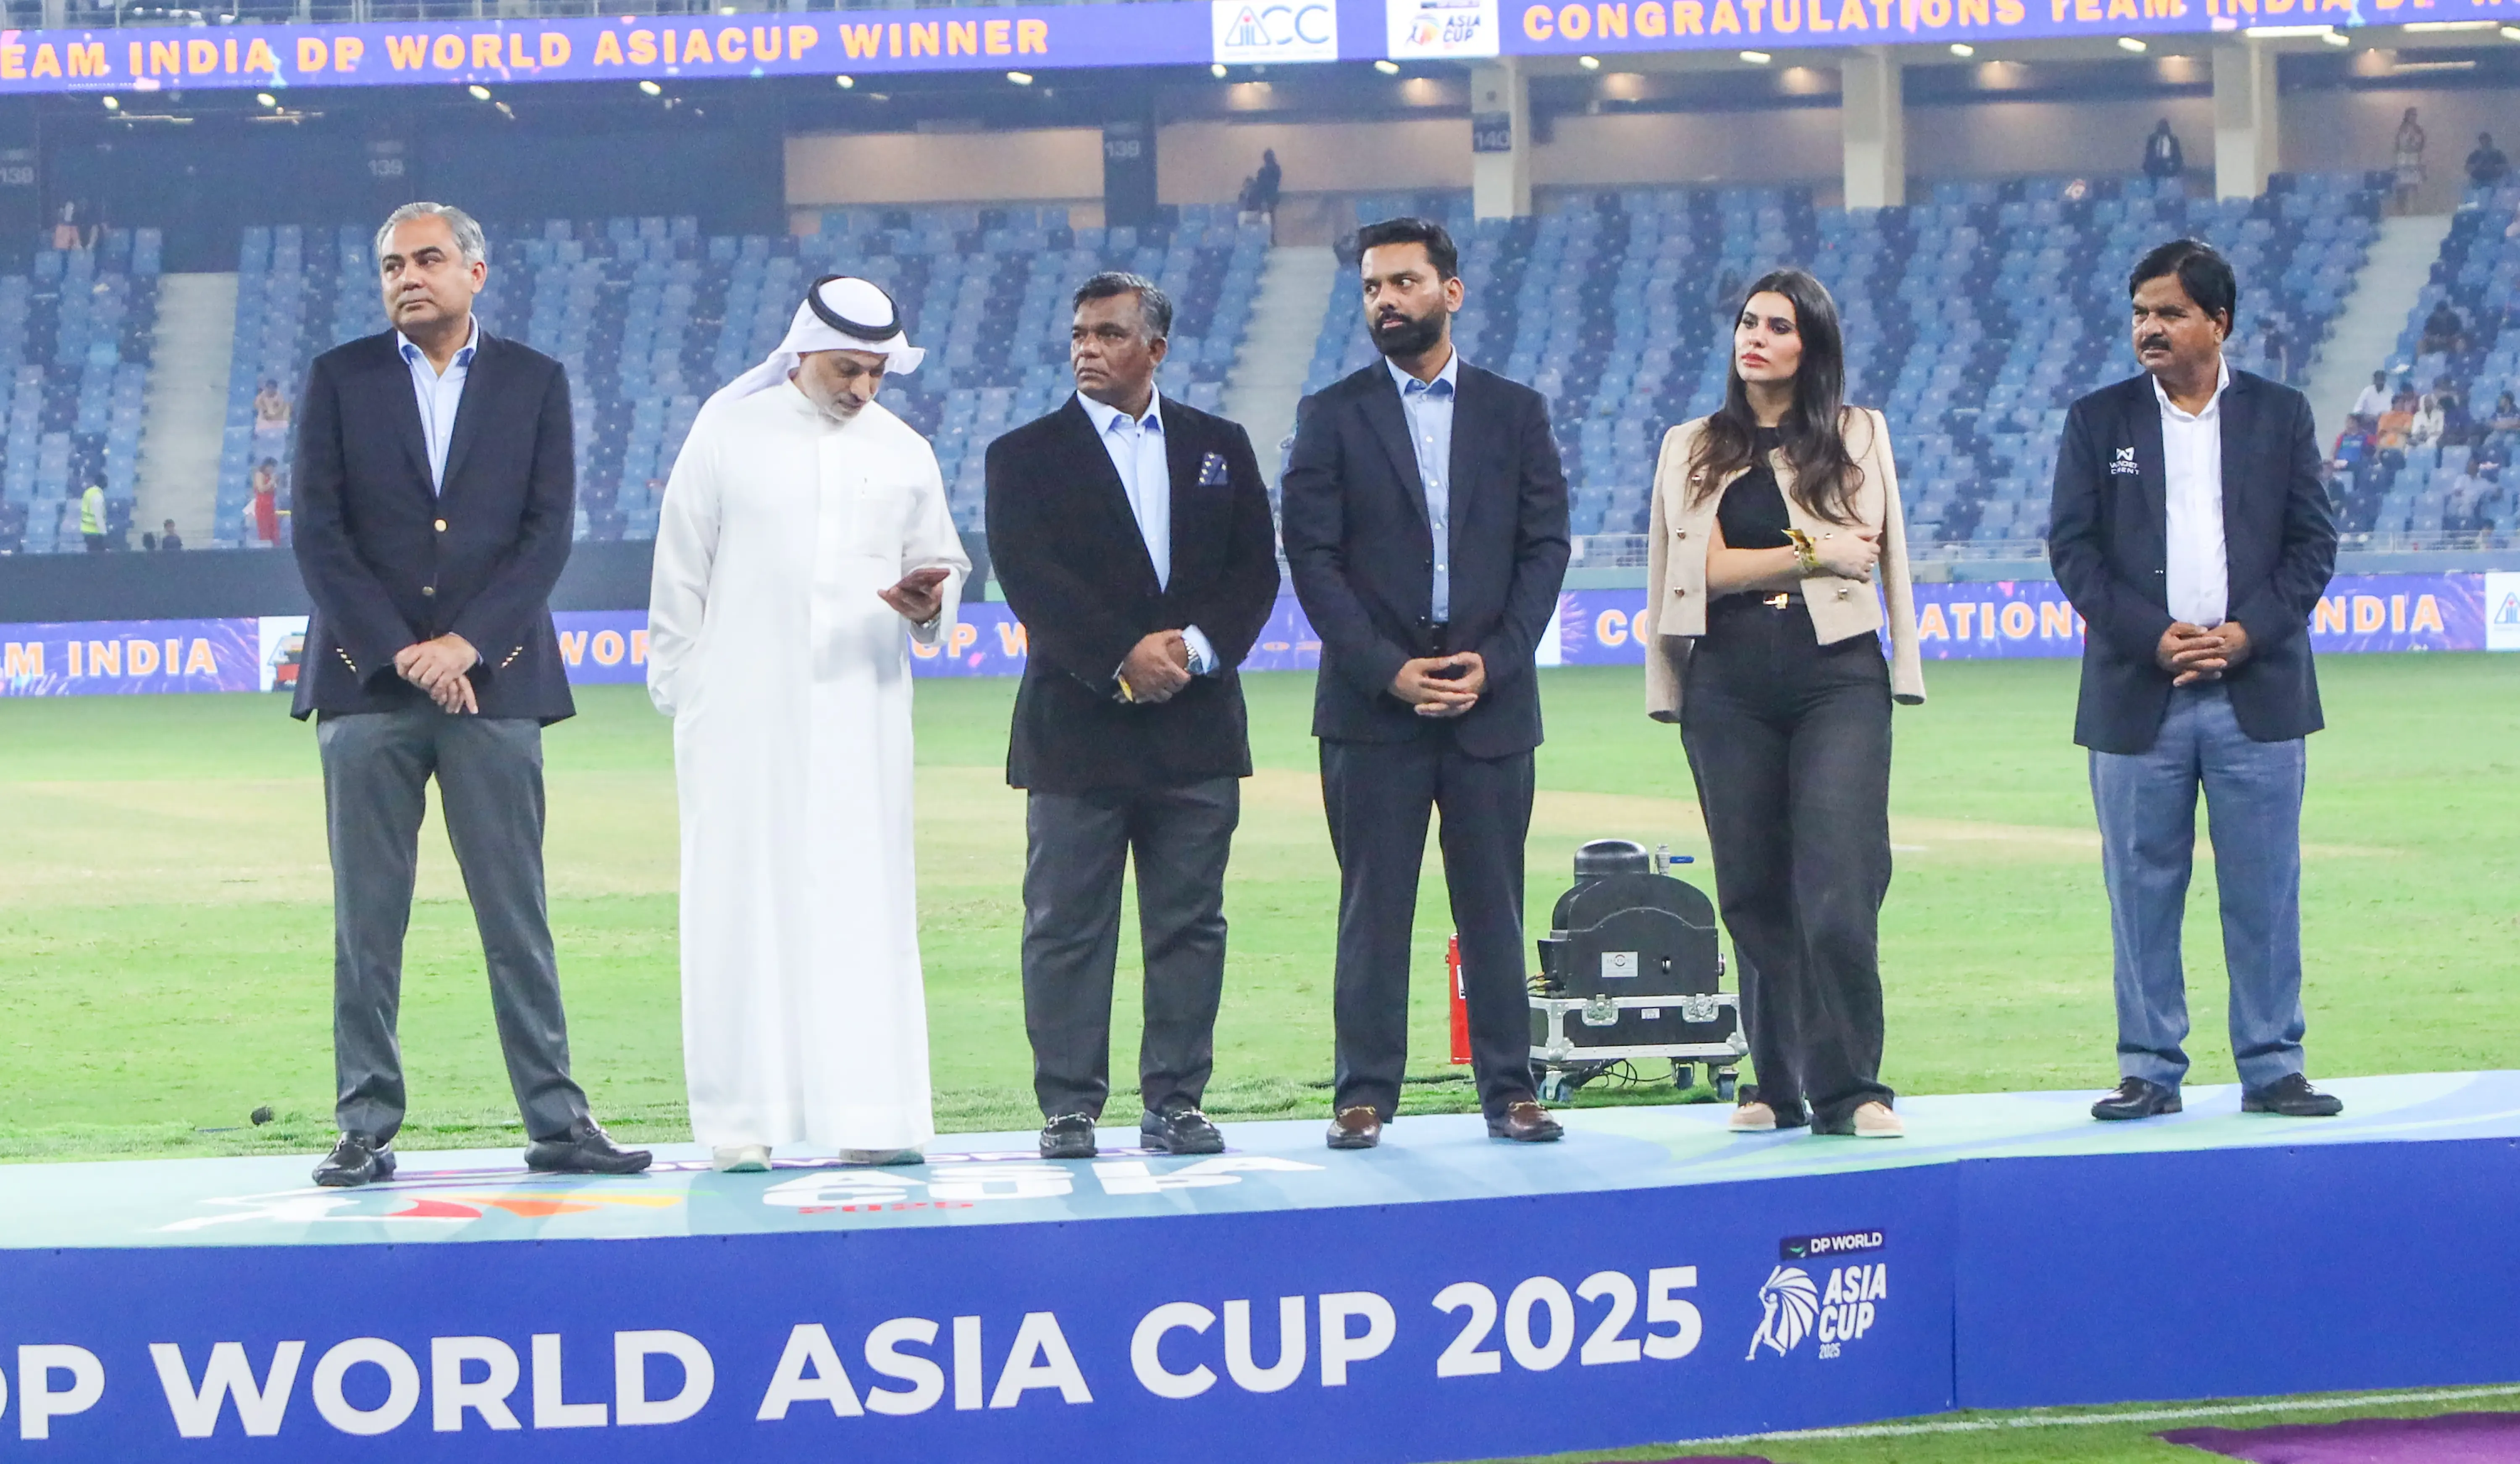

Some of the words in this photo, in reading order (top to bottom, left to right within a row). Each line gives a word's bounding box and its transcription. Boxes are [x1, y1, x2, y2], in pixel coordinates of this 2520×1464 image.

[1443, 27, 1473, 42] CUP
[1447, 16, 1480, 27] ASIA
[129, 39, 275, 76] INDIA
[297, 37, 365, 71] DP
[385, 33, 571, 69] WORLD
[593, 26, 819, 64] ASIACUP
[840, 20, 1049, 58] WINNER
[68, 639, 218, 677] INDIA
[1811, 1238, 1830, 1253] DP
[1831, 1232, 1883, 1250] WORLD
[1822, 1263, 1887, 1306] ASIA
[1819, 1301, 1875, 1343] CUP
[149, 1330, 715, 1438] WORLD
[756, 1312, 1093, 1421] ASIA
[1130, 1292, 1396, 1399] CUP
[1432, 1265, 1702, 1378] 2025
[1819, 1343, 1841, 1359] 2025
